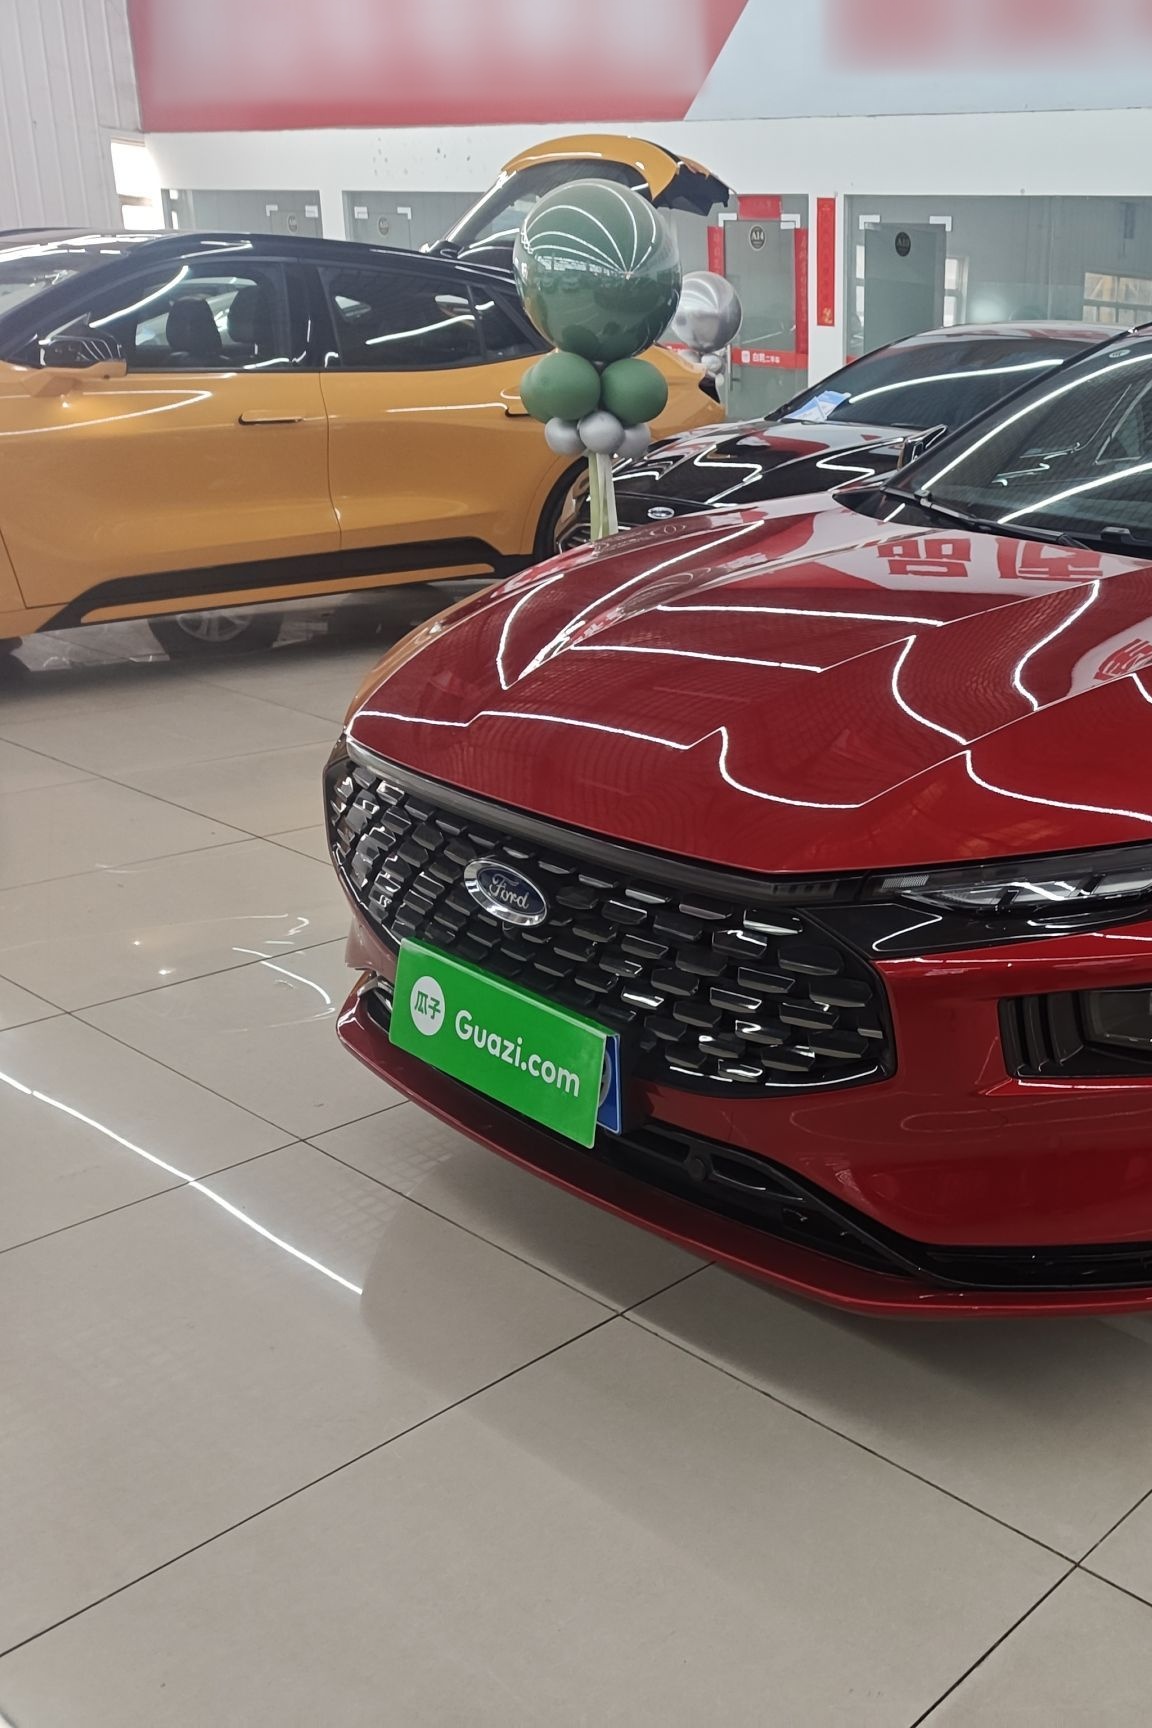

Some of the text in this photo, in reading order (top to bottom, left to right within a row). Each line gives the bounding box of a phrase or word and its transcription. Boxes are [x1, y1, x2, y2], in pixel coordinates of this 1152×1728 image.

[489, 873, 529, 909] Ford
[414, 990, 441, 1020] 瓜子
[455, 1010, 580, 1097] Guazi.com
